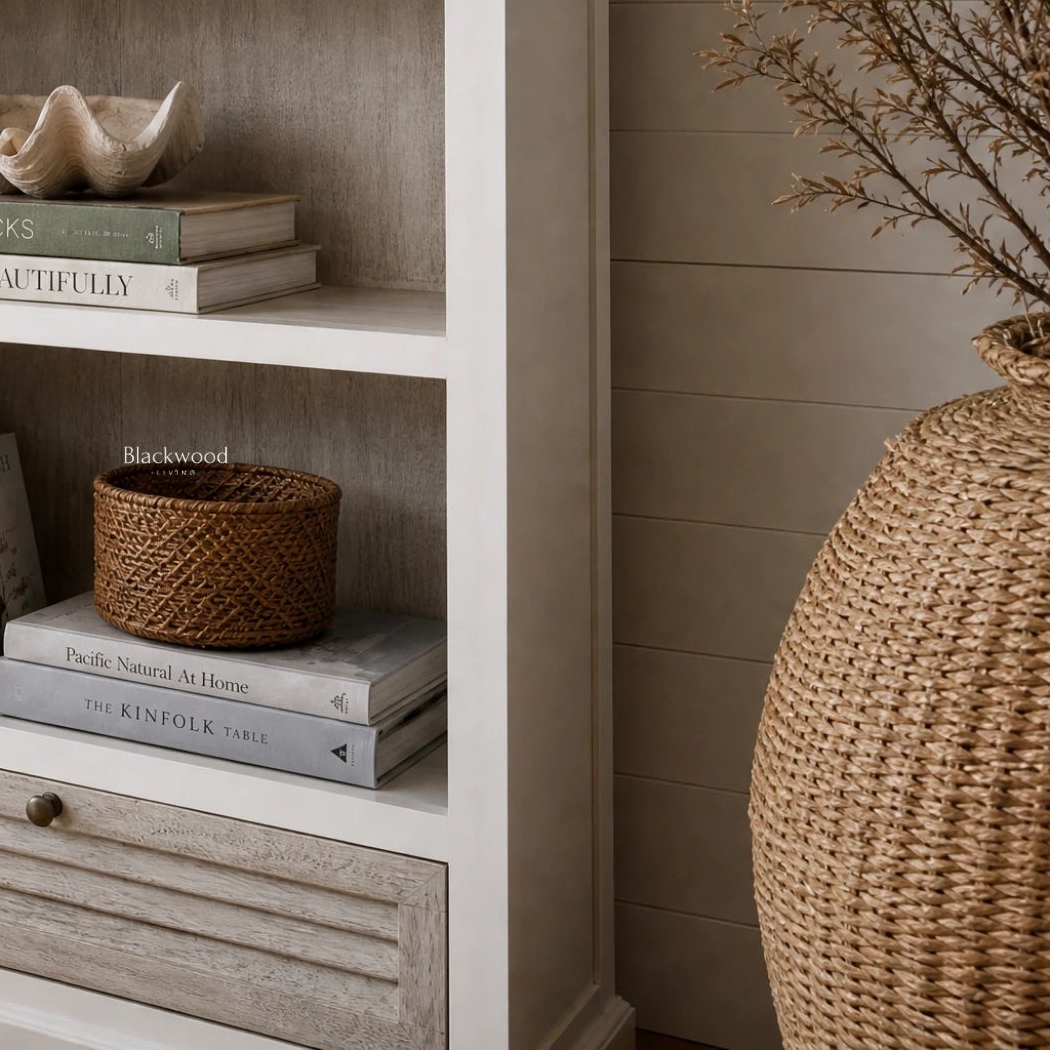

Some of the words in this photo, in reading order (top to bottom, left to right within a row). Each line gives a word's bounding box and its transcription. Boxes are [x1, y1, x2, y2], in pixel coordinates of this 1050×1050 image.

[65, 646, 112, 670] Pacific
[116, 656, 172, 681] Natural
[177, 668, 196, 686] At
[201, 672, 249, 695] Home
[84, 697, 114, 715] THE
[120, 702, 215, 736] KINFOLK
[223, 725, 269, 746] TABLE
